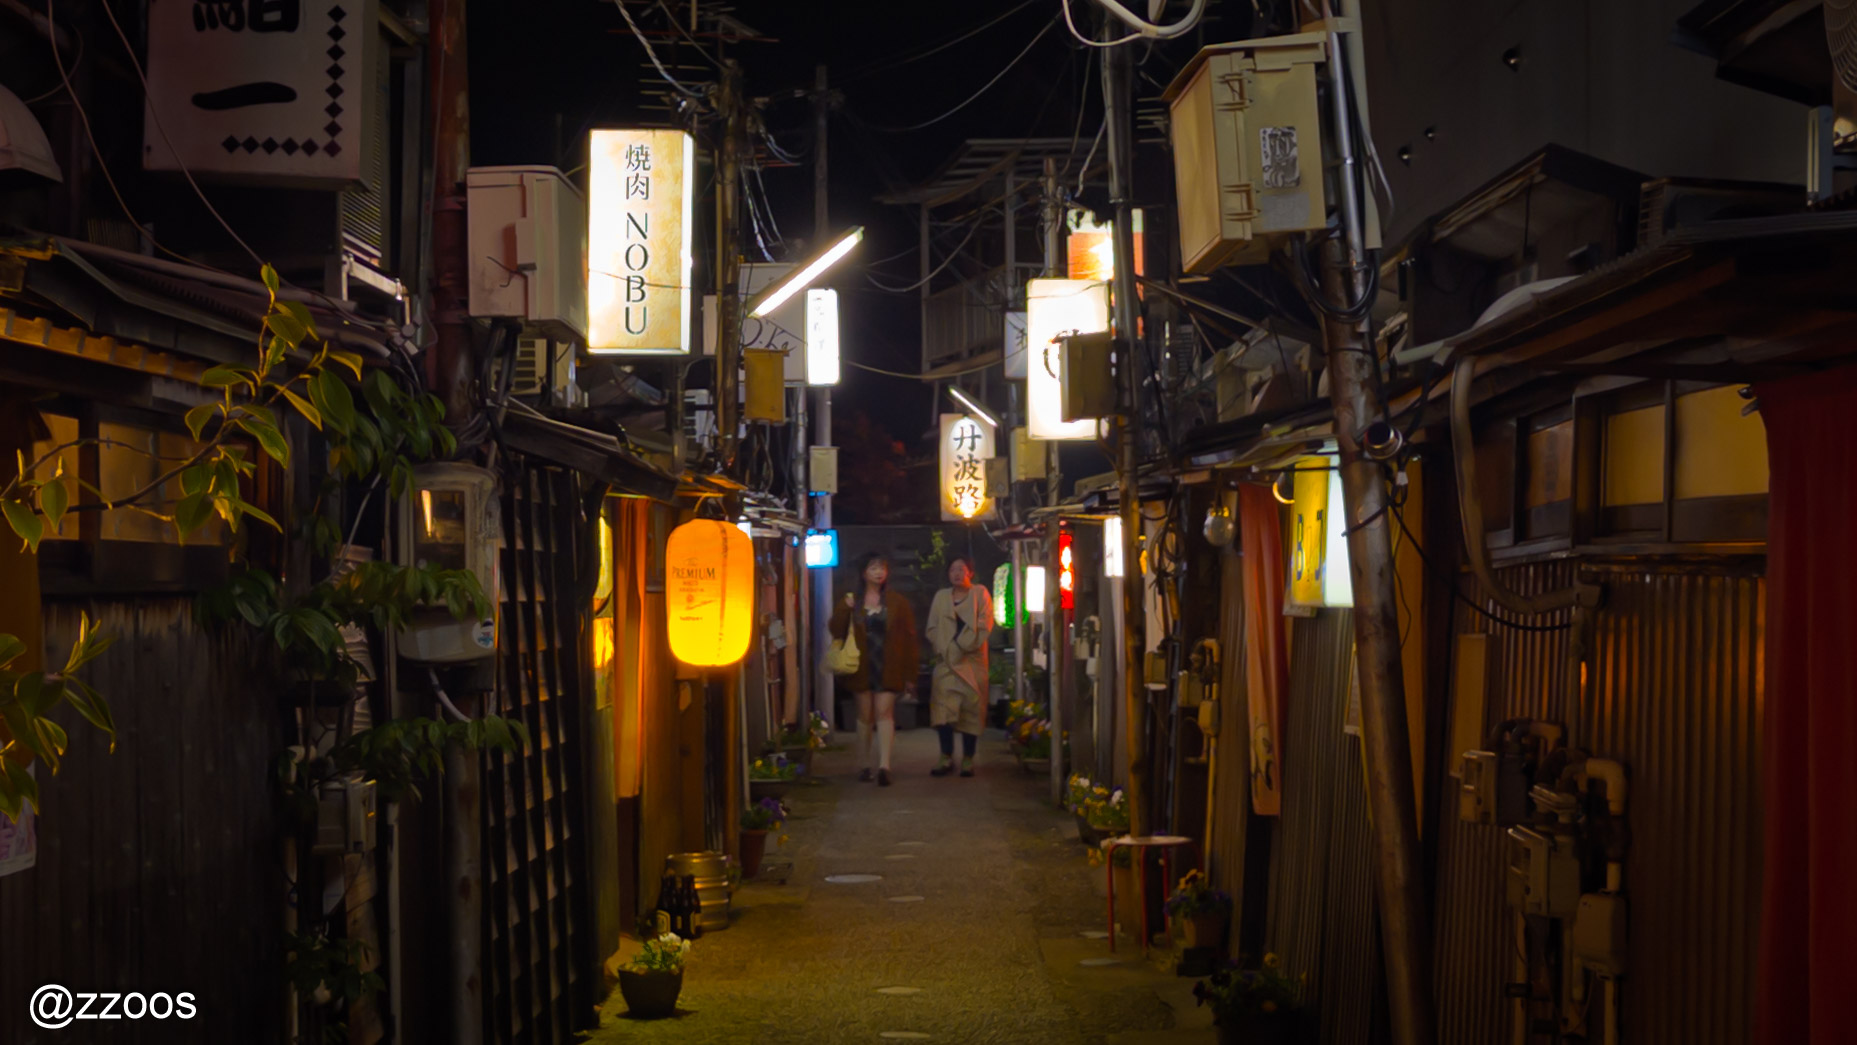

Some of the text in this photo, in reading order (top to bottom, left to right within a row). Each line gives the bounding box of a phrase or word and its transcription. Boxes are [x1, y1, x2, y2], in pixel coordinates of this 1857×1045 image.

[625, 144, 651, 335] 焼肉 NOBU
[672, 566, 715, 580] PREMIUM
